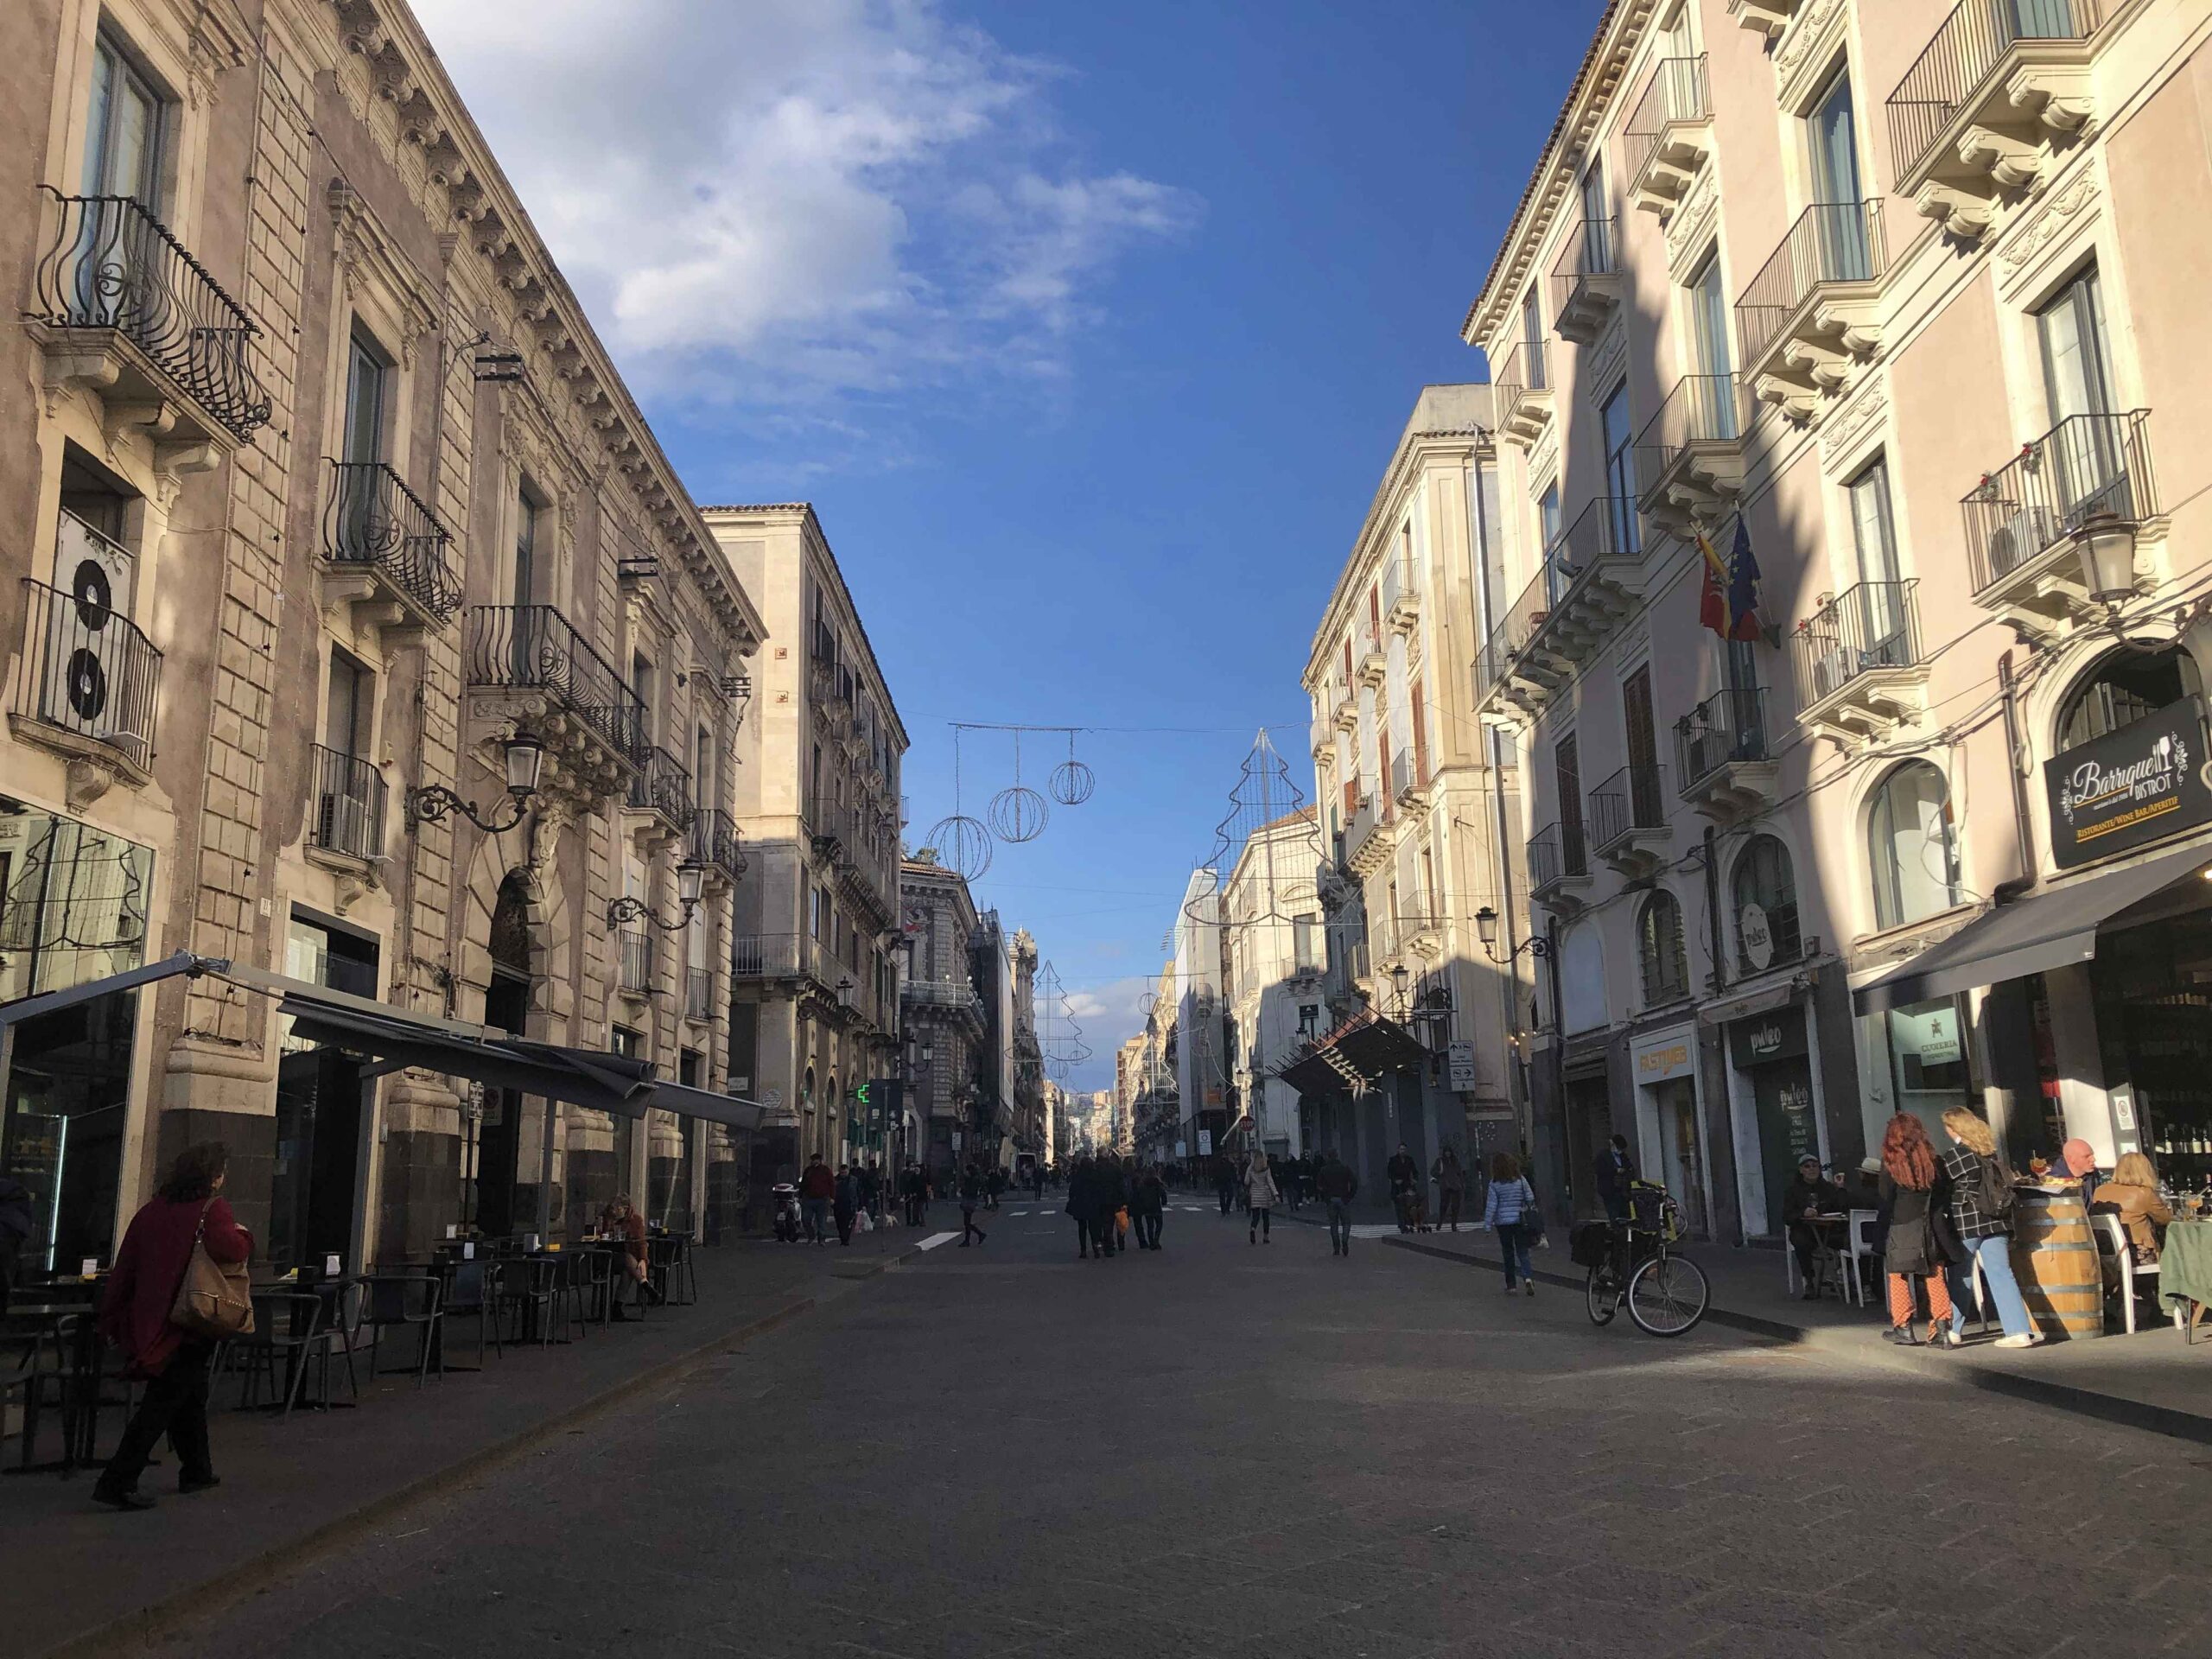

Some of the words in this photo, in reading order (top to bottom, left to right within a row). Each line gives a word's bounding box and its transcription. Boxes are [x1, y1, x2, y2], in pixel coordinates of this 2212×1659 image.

[2073, 760, 2154, 804] Barrique
[2134, 773, 2171, 801] BISTROT
[1750, 1021, 1781, 1058] puleo
